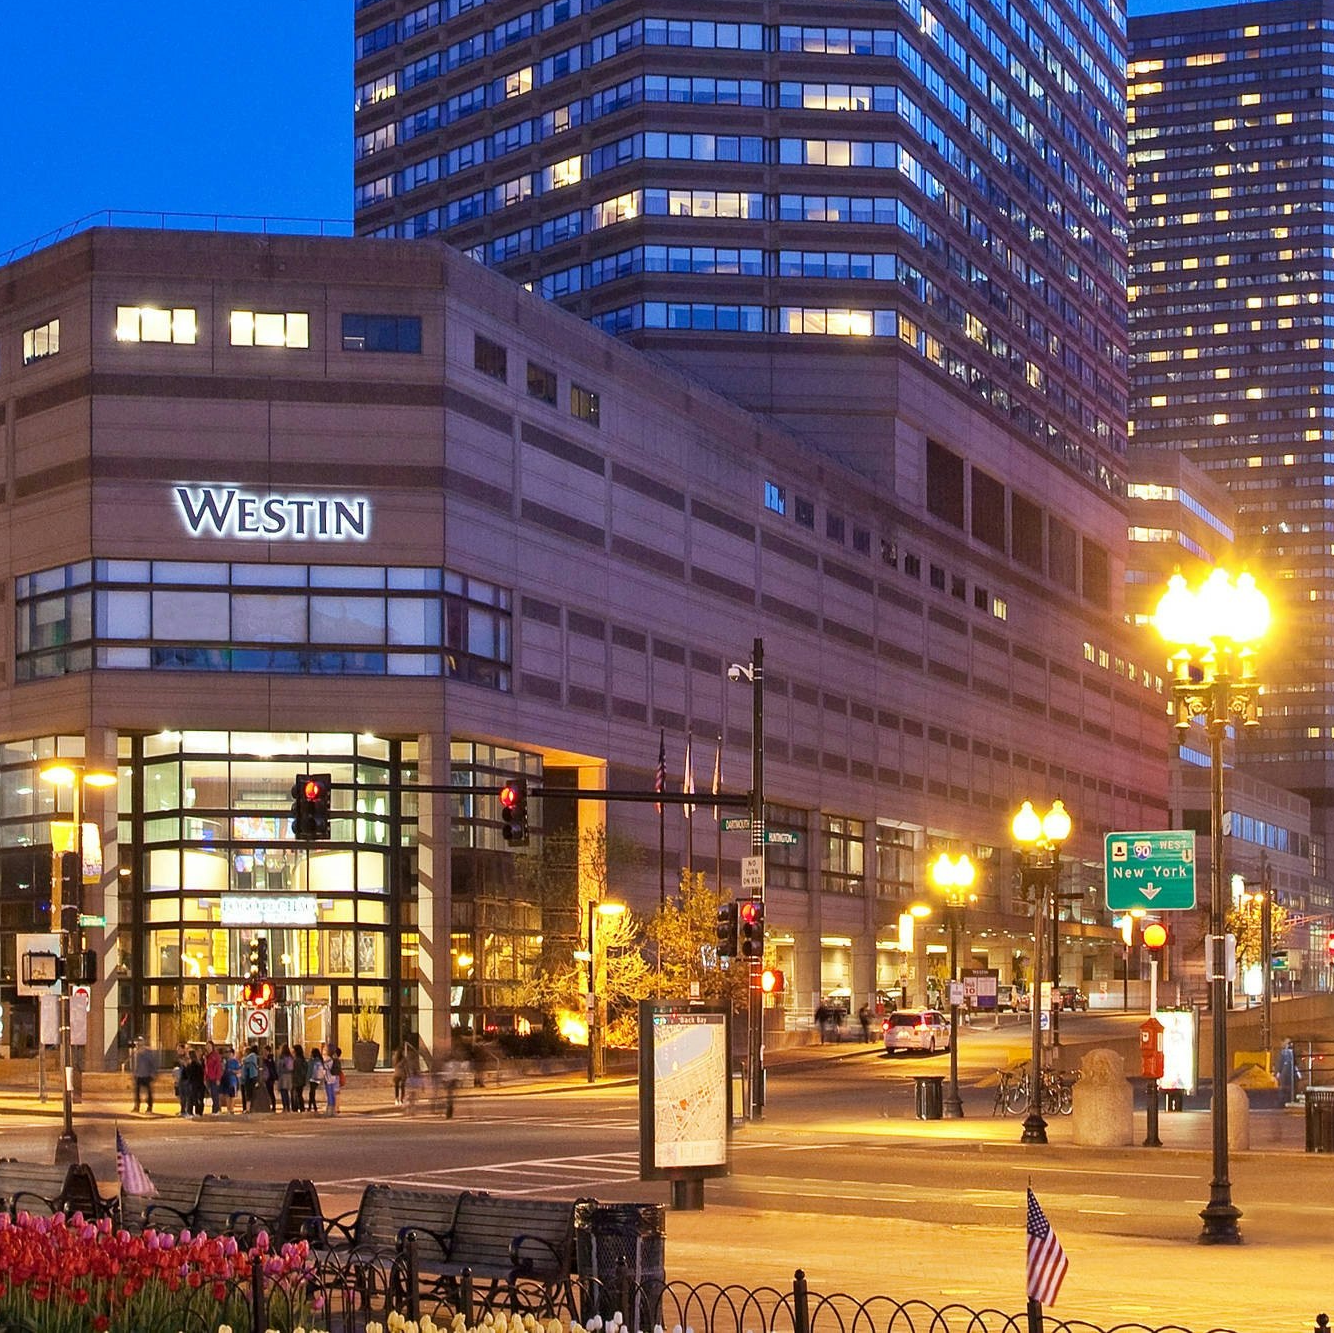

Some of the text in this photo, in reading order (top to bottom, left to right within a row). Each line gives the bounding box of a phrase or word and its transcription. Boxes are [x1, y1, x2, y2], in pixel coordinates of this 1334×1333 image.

[176, 487, 366, 536] WESTIN
[769, 832, 793, 844] HUNTINGTON
[1135, 840, 1187, 857] 90 WEST
[1113, 865, 1187, 879] New York
[679, 1016, 707, 1025] Back Bay
